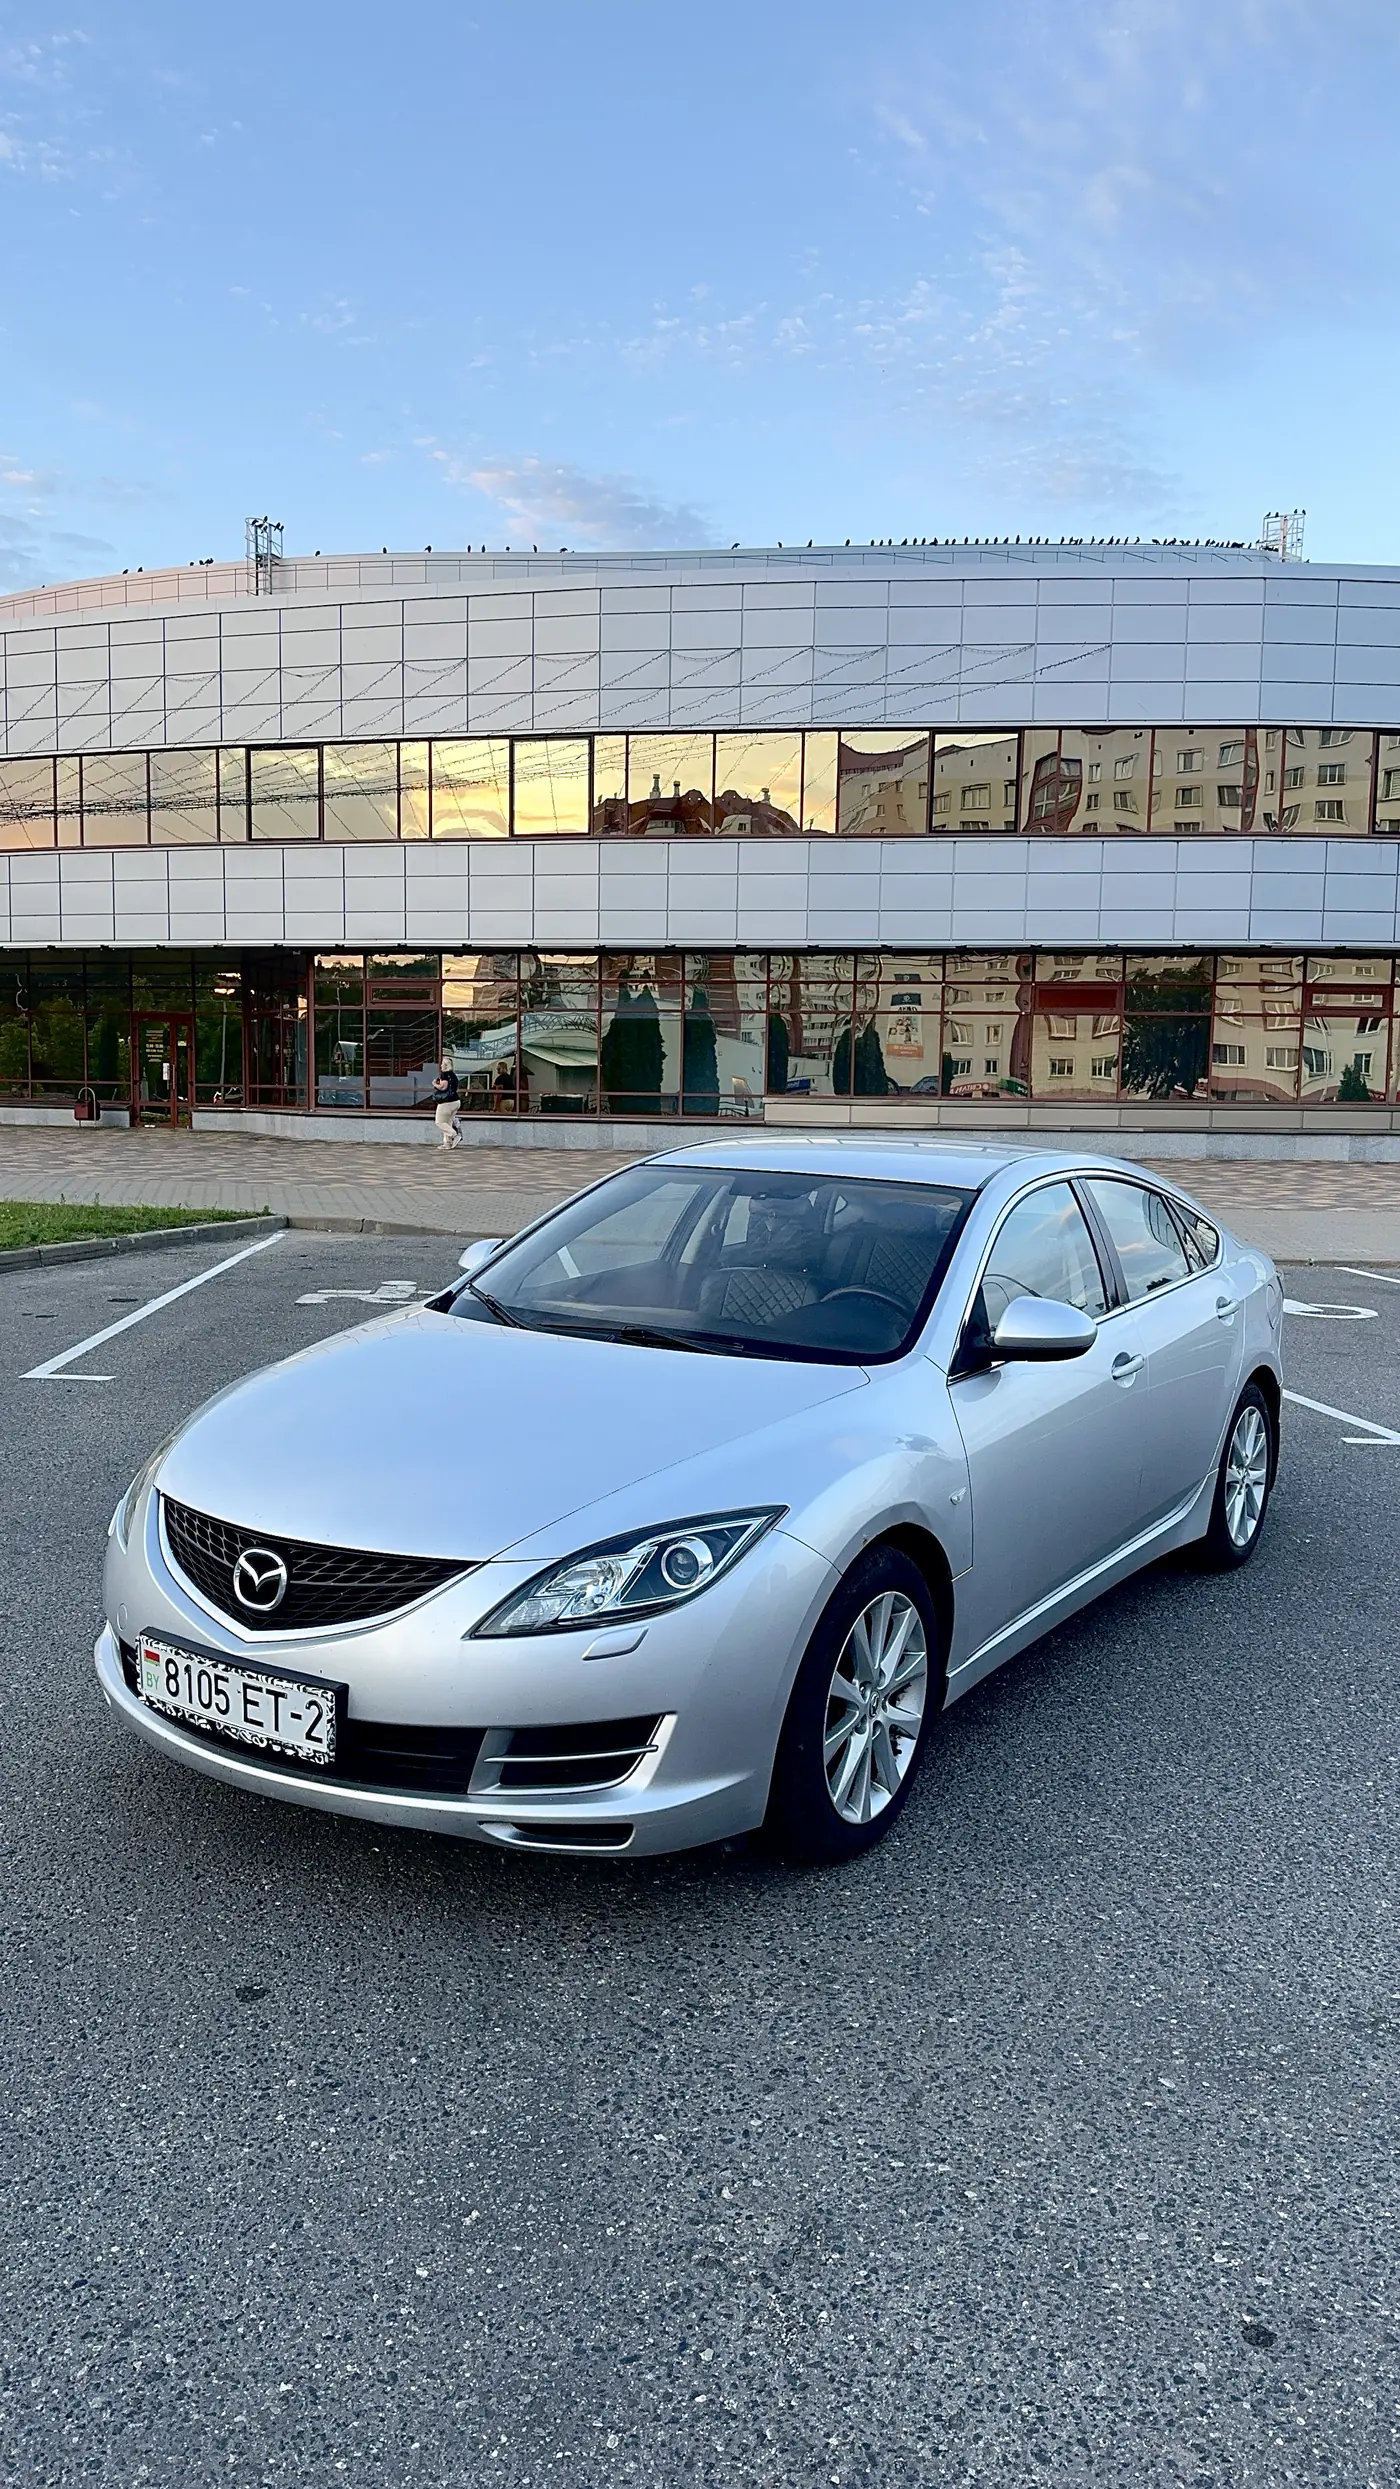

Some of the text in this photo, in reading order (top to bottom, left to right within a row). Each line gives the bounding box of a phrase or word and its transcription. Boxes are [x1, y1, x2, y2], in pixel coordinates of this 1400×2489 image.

[146, 1671, 160, 1690] BY
[165, 1657, 324, 1744] 8105 ET-2
